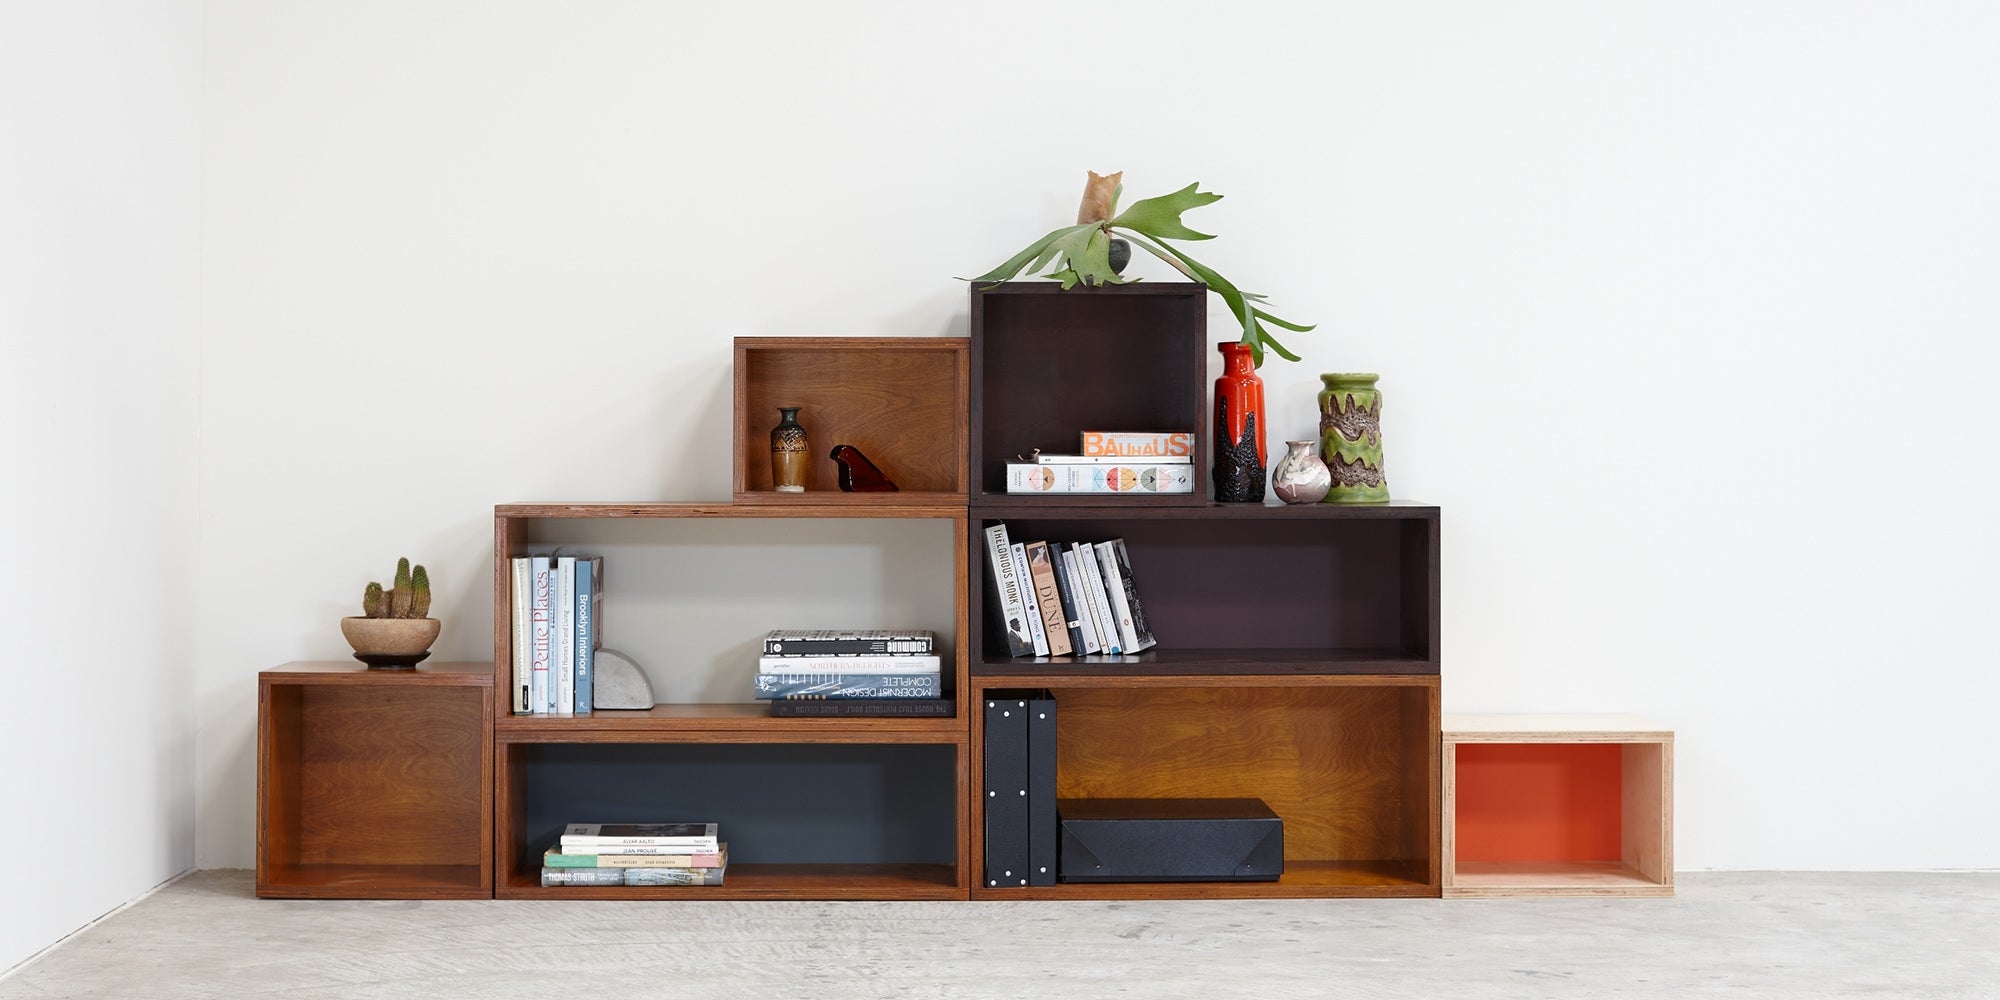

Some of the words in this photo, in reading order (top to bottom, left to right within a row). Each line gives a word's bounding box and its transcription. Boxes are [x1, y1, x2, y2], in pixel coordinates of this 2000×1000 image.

[1084, 432, 1190, 456] BAUHAUS
[994, 529, 1011, 578] THELONIOUS
[1005, 580, 1018, 604] MONK
[534, 571, 548, 623] Places
[1023, 578, 1032, 603] MULTITUDES
[562, 610, 570, 627] Living
[577, 595, 588, 636] Brooklyn
[1040, 586, 1062, 632] DUNE
[534, 627, 548, 672] Petite
[579, 637, 588, 676] Interiors
[842, 688, 877, 696] DESIGN
[878, 688, 932, 696] MODERNIST
[883, 677, 932, 685] COMPLETE
[548, 873, 571, 881] THOMAS
[573, 873, 594, 881] STRUTH
